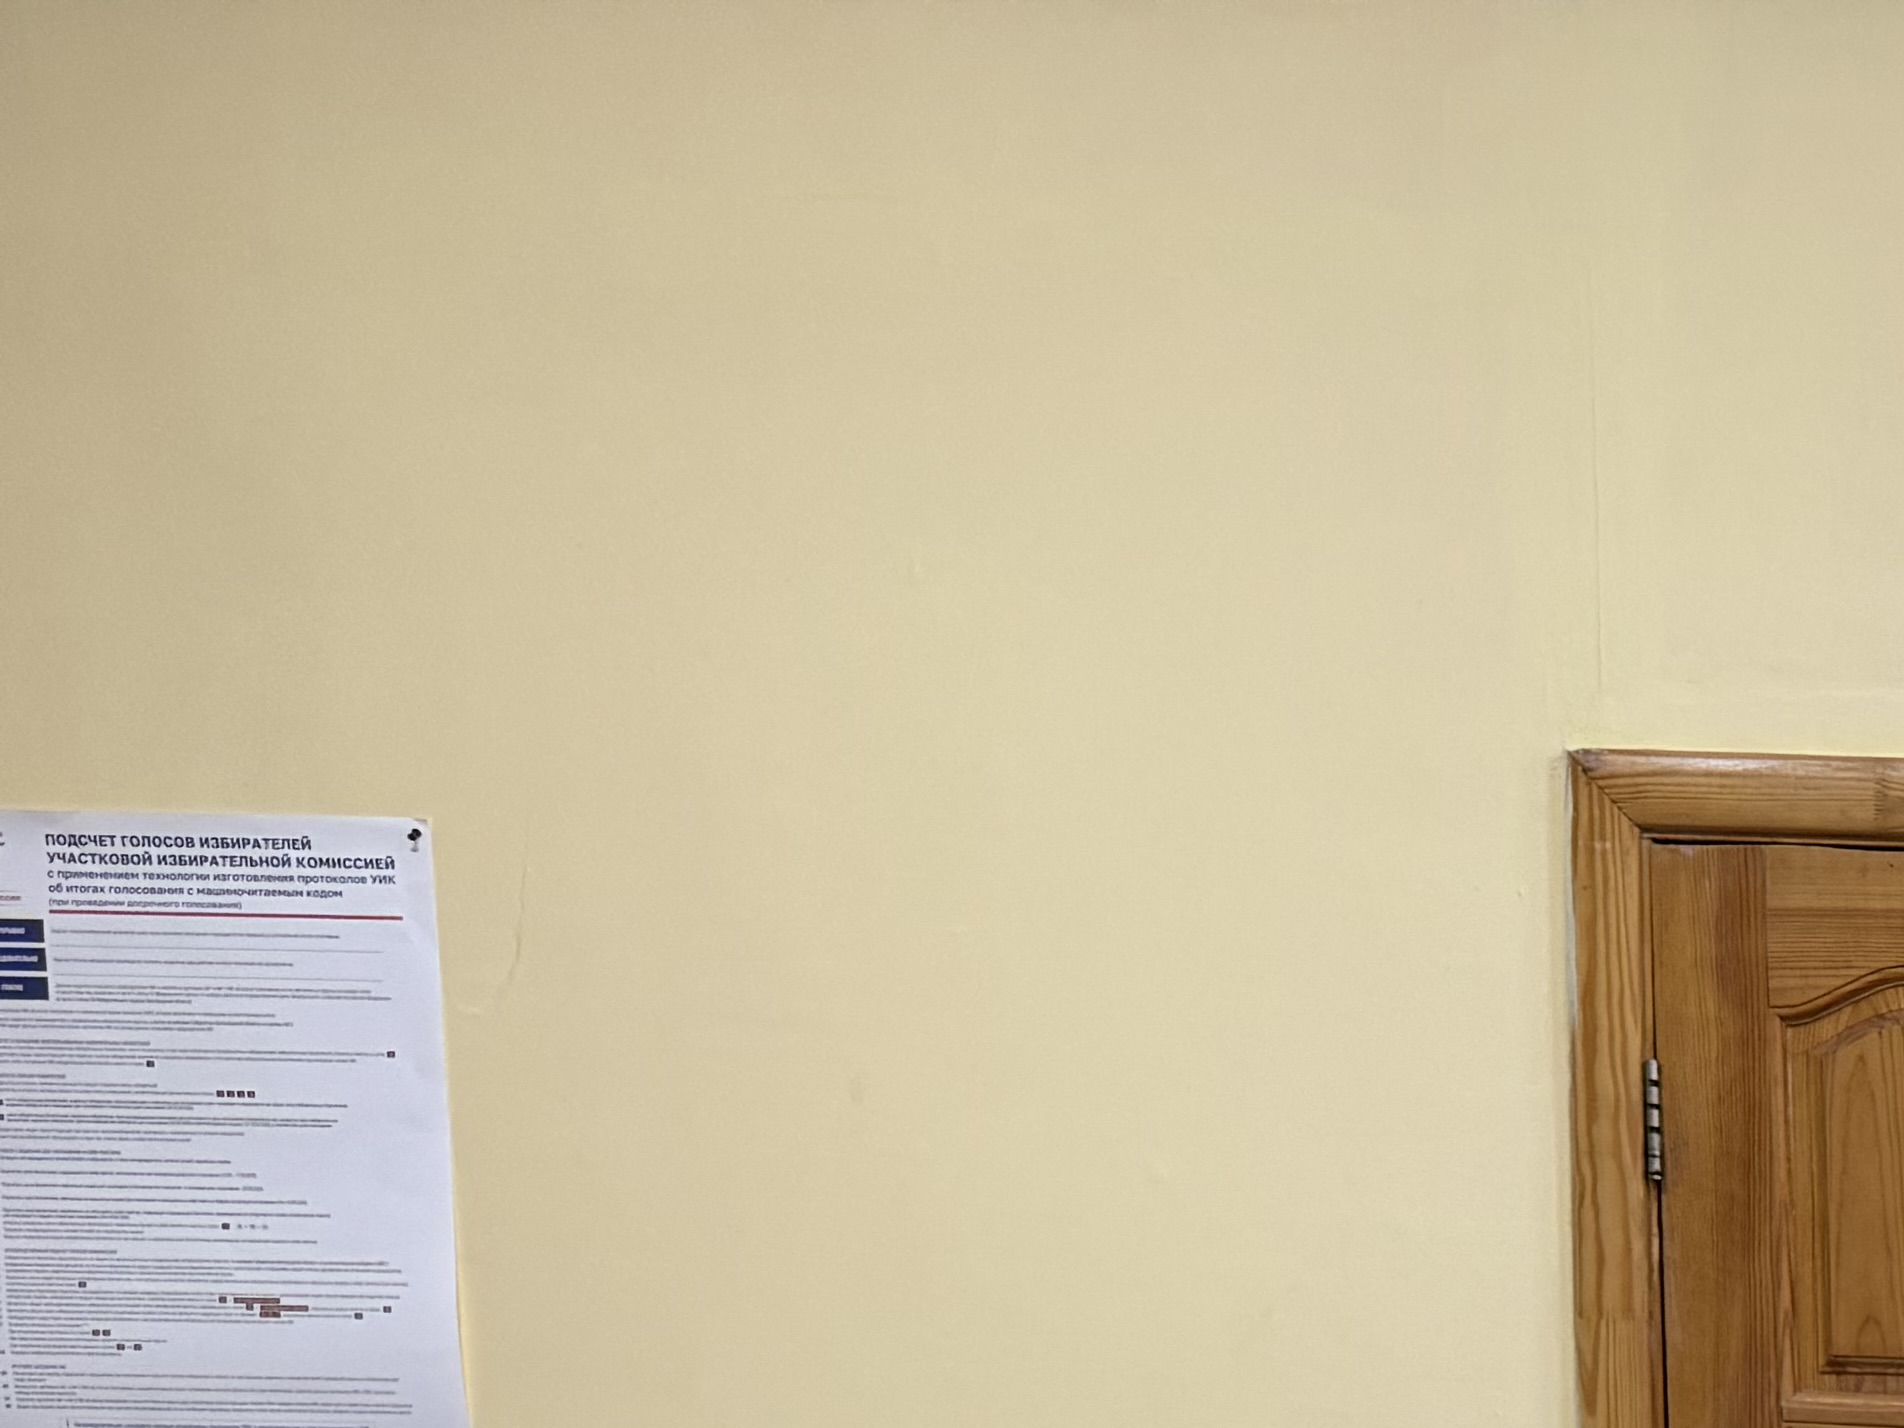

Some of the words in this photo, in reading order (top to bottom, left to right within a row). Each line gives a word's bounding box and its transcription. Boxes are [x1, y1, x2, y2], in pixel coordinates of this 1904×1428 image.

[45, 834, 117, 848] ПОДСЧЕТ
[121, 835, 195, 848] ГОЛОСОВ
[199, 836, 312, 850] ИЗБИРАТЕЛЕЙ
[47, 851, 152, 866] УЧАСТКОВОЙ
[157, 853, 292, 868] ИЗБИРАТЕЛЬНОЙ
[296, 856, 395, 870] КОМИССИЕЙ
[47, 870, 54, 878] с
[57, 871, 139, 880] применением
[142, 872, 210, 881] технологии
[213, 872, 295, 882] изготовления
[297, 875, 367, 885] протоколов
[370, 874, 396, 885] УИК
[49, 883, 63, 893] об
[66, 885, 105, 894] итогах
[109, 886, 184, 895] голосования
[187, 887, 193, 895] с
[306, 889, 343, 898] кодом
